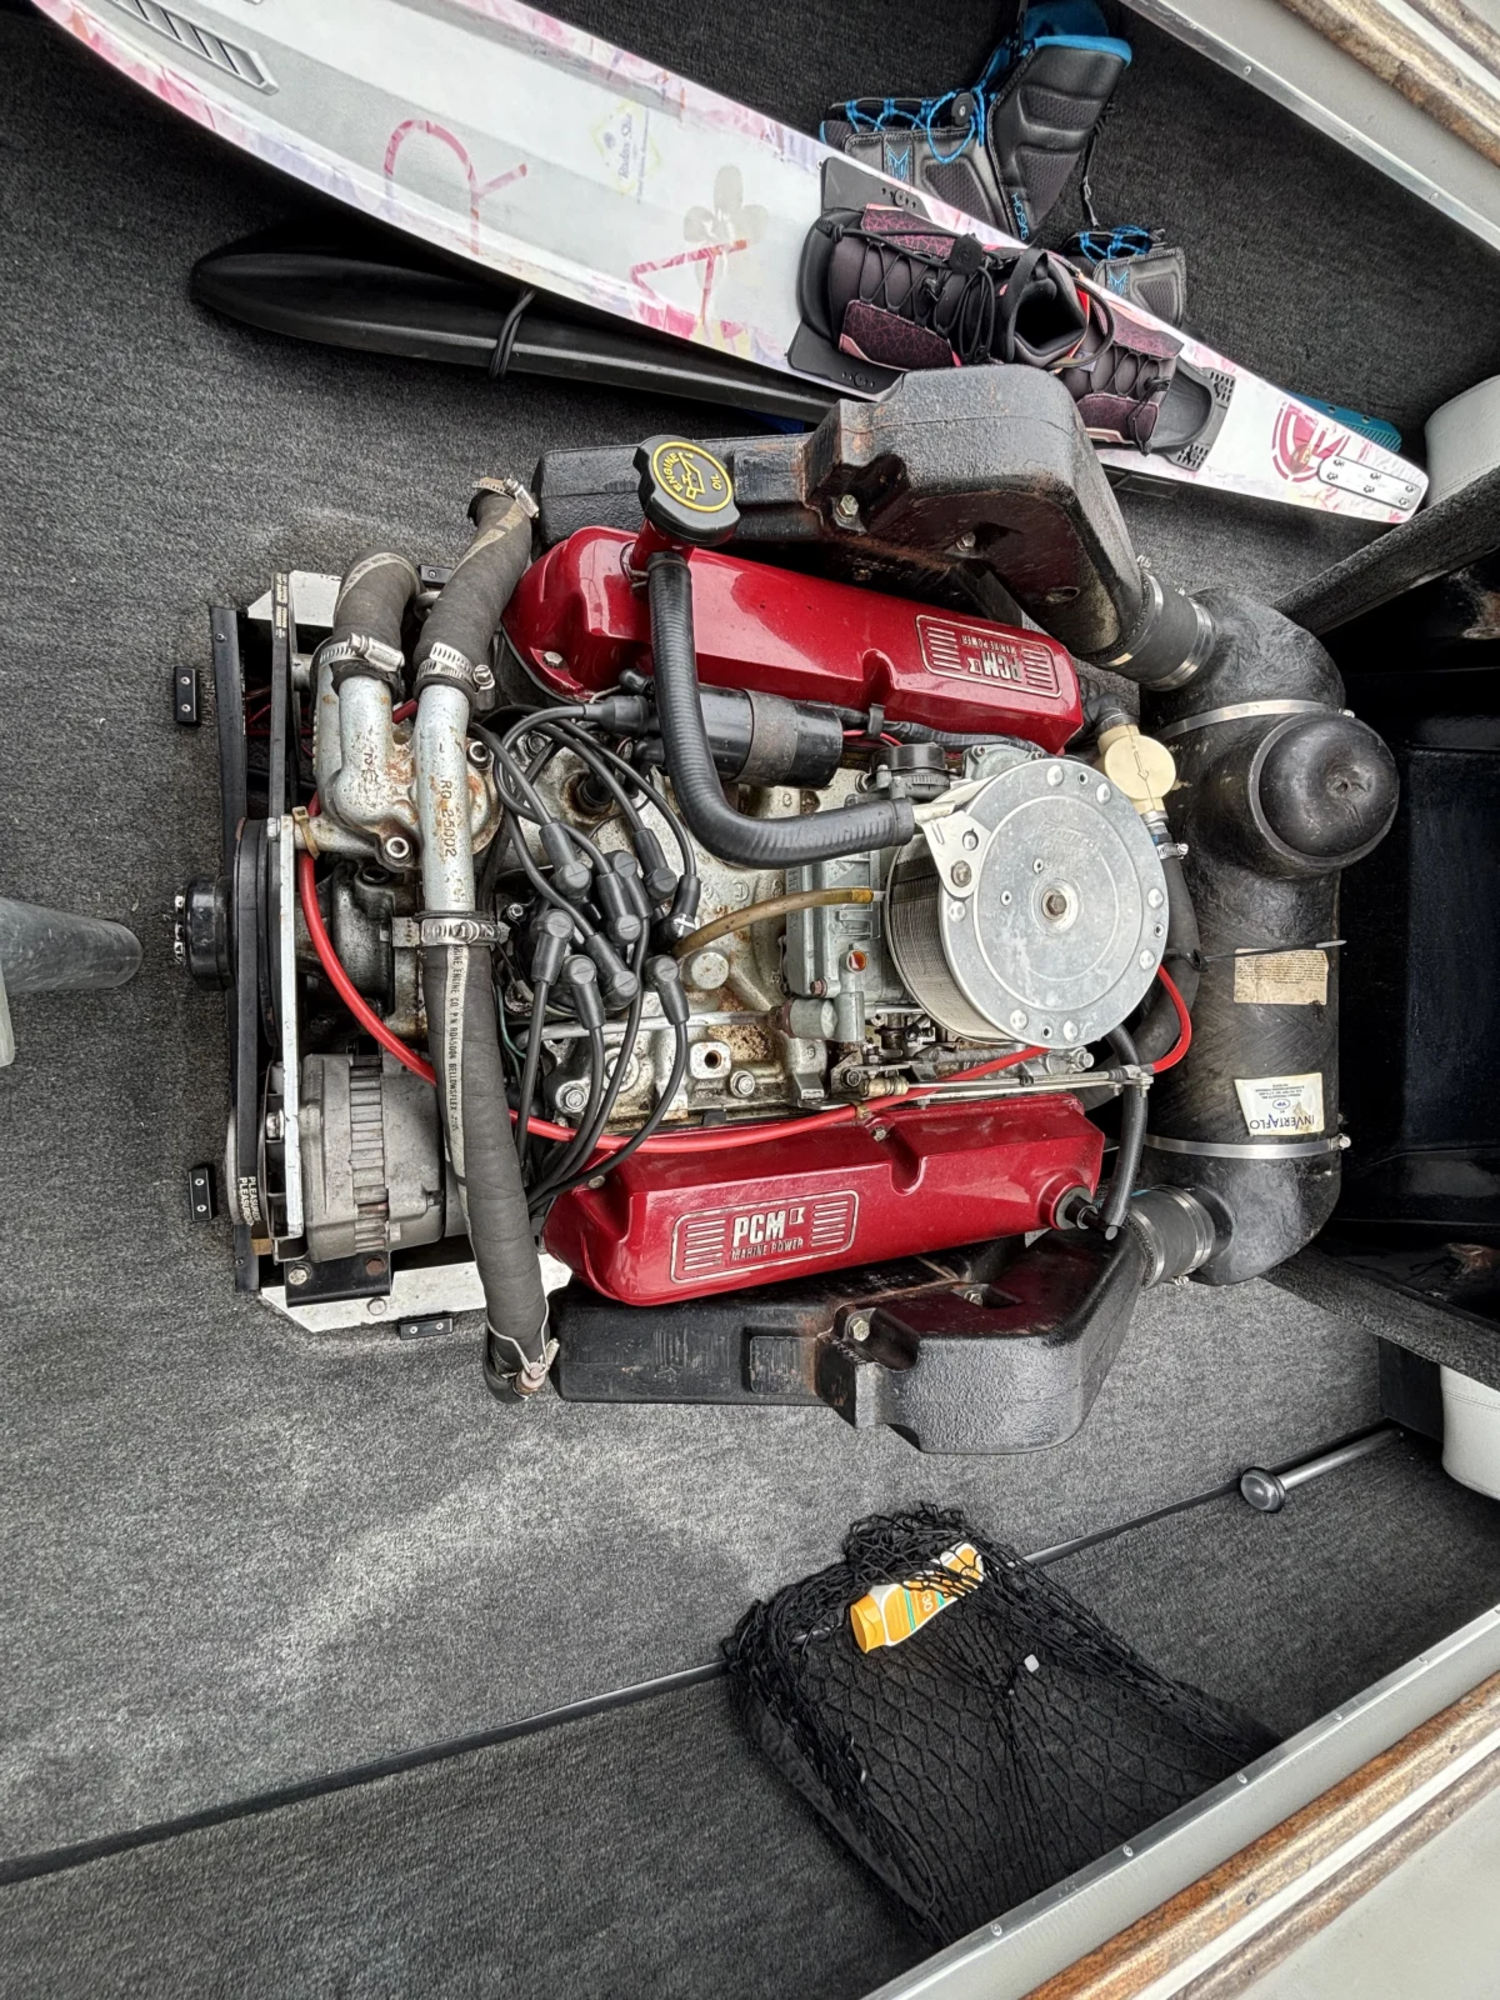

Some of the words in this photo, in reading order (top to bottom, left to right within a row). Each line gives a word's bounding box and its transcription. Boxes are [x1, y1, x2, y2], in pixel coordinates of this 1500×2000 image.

[663, 452, 684, 493] ENGINE
[710, 473, 722, 491] OIL
[961, 634, 989, 649] POWER
[990, 641, 1017, 656] MARINE
[981, 651, 1022, 684] PCM
[442, 809, 457, 857] 25002
[451, 968, 462, 994] ENGINE
[448, 1063, 458, 1111] BELLOWSFLEX
[1249, 1113, 1315, 1131] INVERTAFLO
[732, 1210, 786, 1248] PCM
[731, 1244, 767, 1261] MARINE
[770, 1238, 804, 1254] POWER
[922, 1592, 934, 1612] 30
